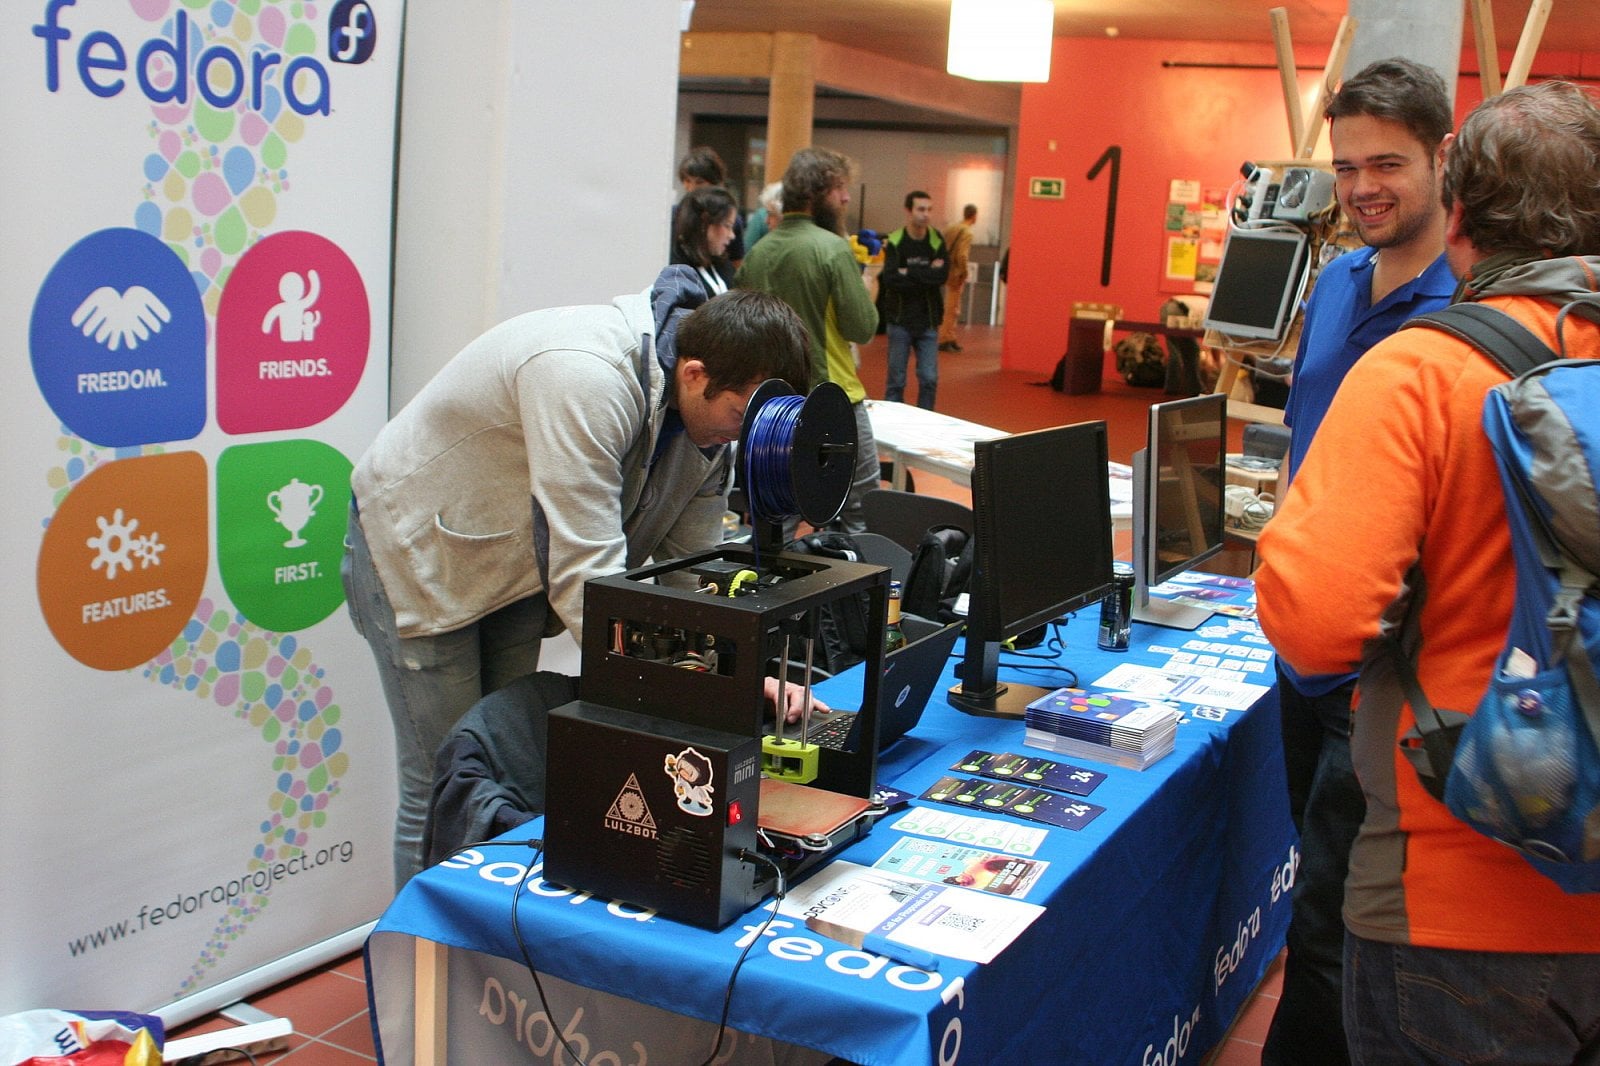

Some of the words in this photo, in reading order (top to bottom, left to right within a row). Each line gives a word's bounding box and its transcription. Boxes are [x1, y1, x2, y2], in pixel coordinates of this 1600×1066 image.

[32, 0, 330, 117] fedora
[1086, 145, 1122, 287] 1
[77, 368, 168, 394] FREEDOM.
[258, 357, 333, 380] FRIENDS.
[274, 561, 323, 585] FIRST.
[81, 588, 172, 624] FEATURES.
[1069, 769, 1095, 784] 24
[1063, 802, 1092, 818] 24
[603, 818, 658, 840] LULZBOT
[68, 839, 354, 958] www.fedoraproject.org
[1213, 905, 1261, 997] fedora
